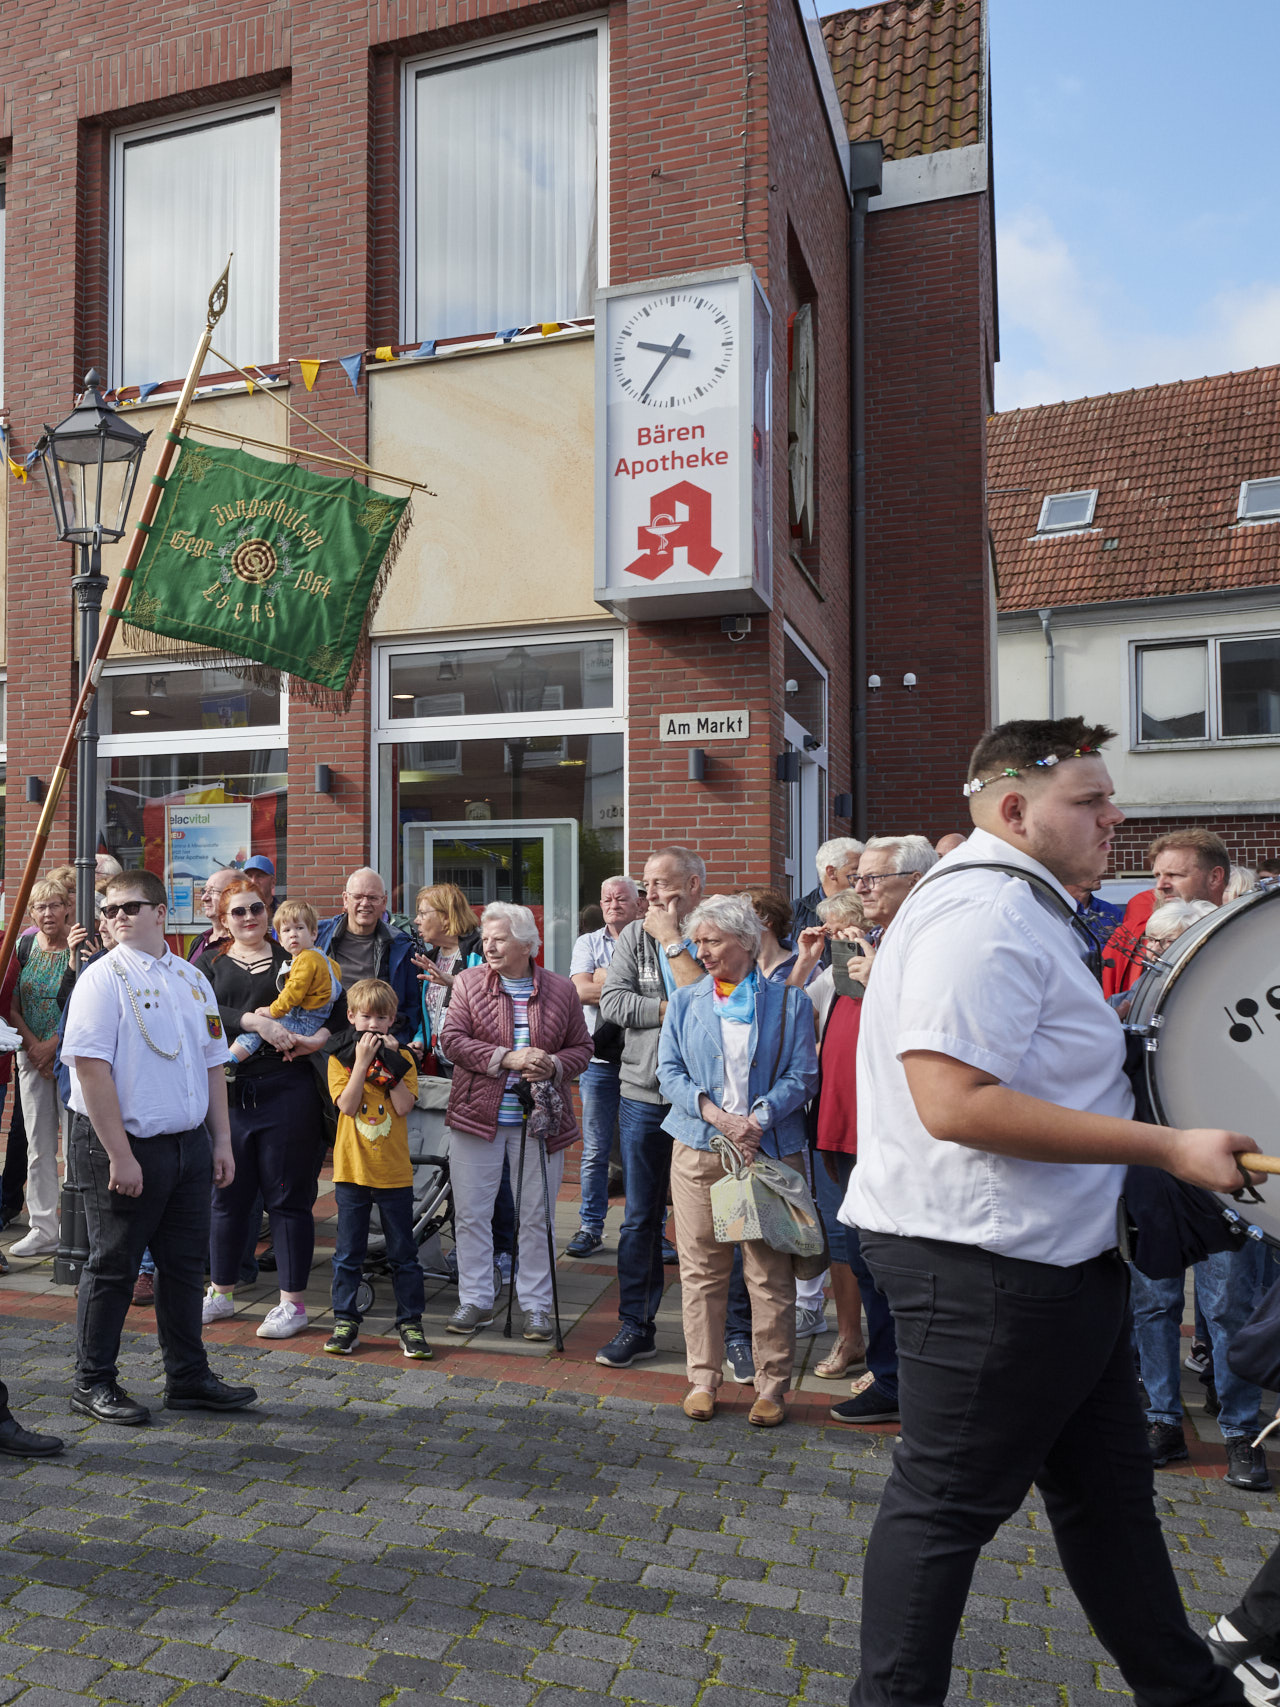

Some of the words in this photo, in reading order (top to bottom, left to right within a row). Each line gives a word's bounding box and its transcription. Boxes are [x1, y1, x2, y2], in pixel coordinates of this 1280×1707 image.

[637, 424, 705, 446] Bären
[614, 447, 729, 480] Apotheke
[210, 498, 324, 552] Jungschützen
[293, 569, 333, 600] 1964
[202, 581, 276, 624] Esens
[667, 719, 690, 735] Am
[697, 716, 743, 733] Markt
